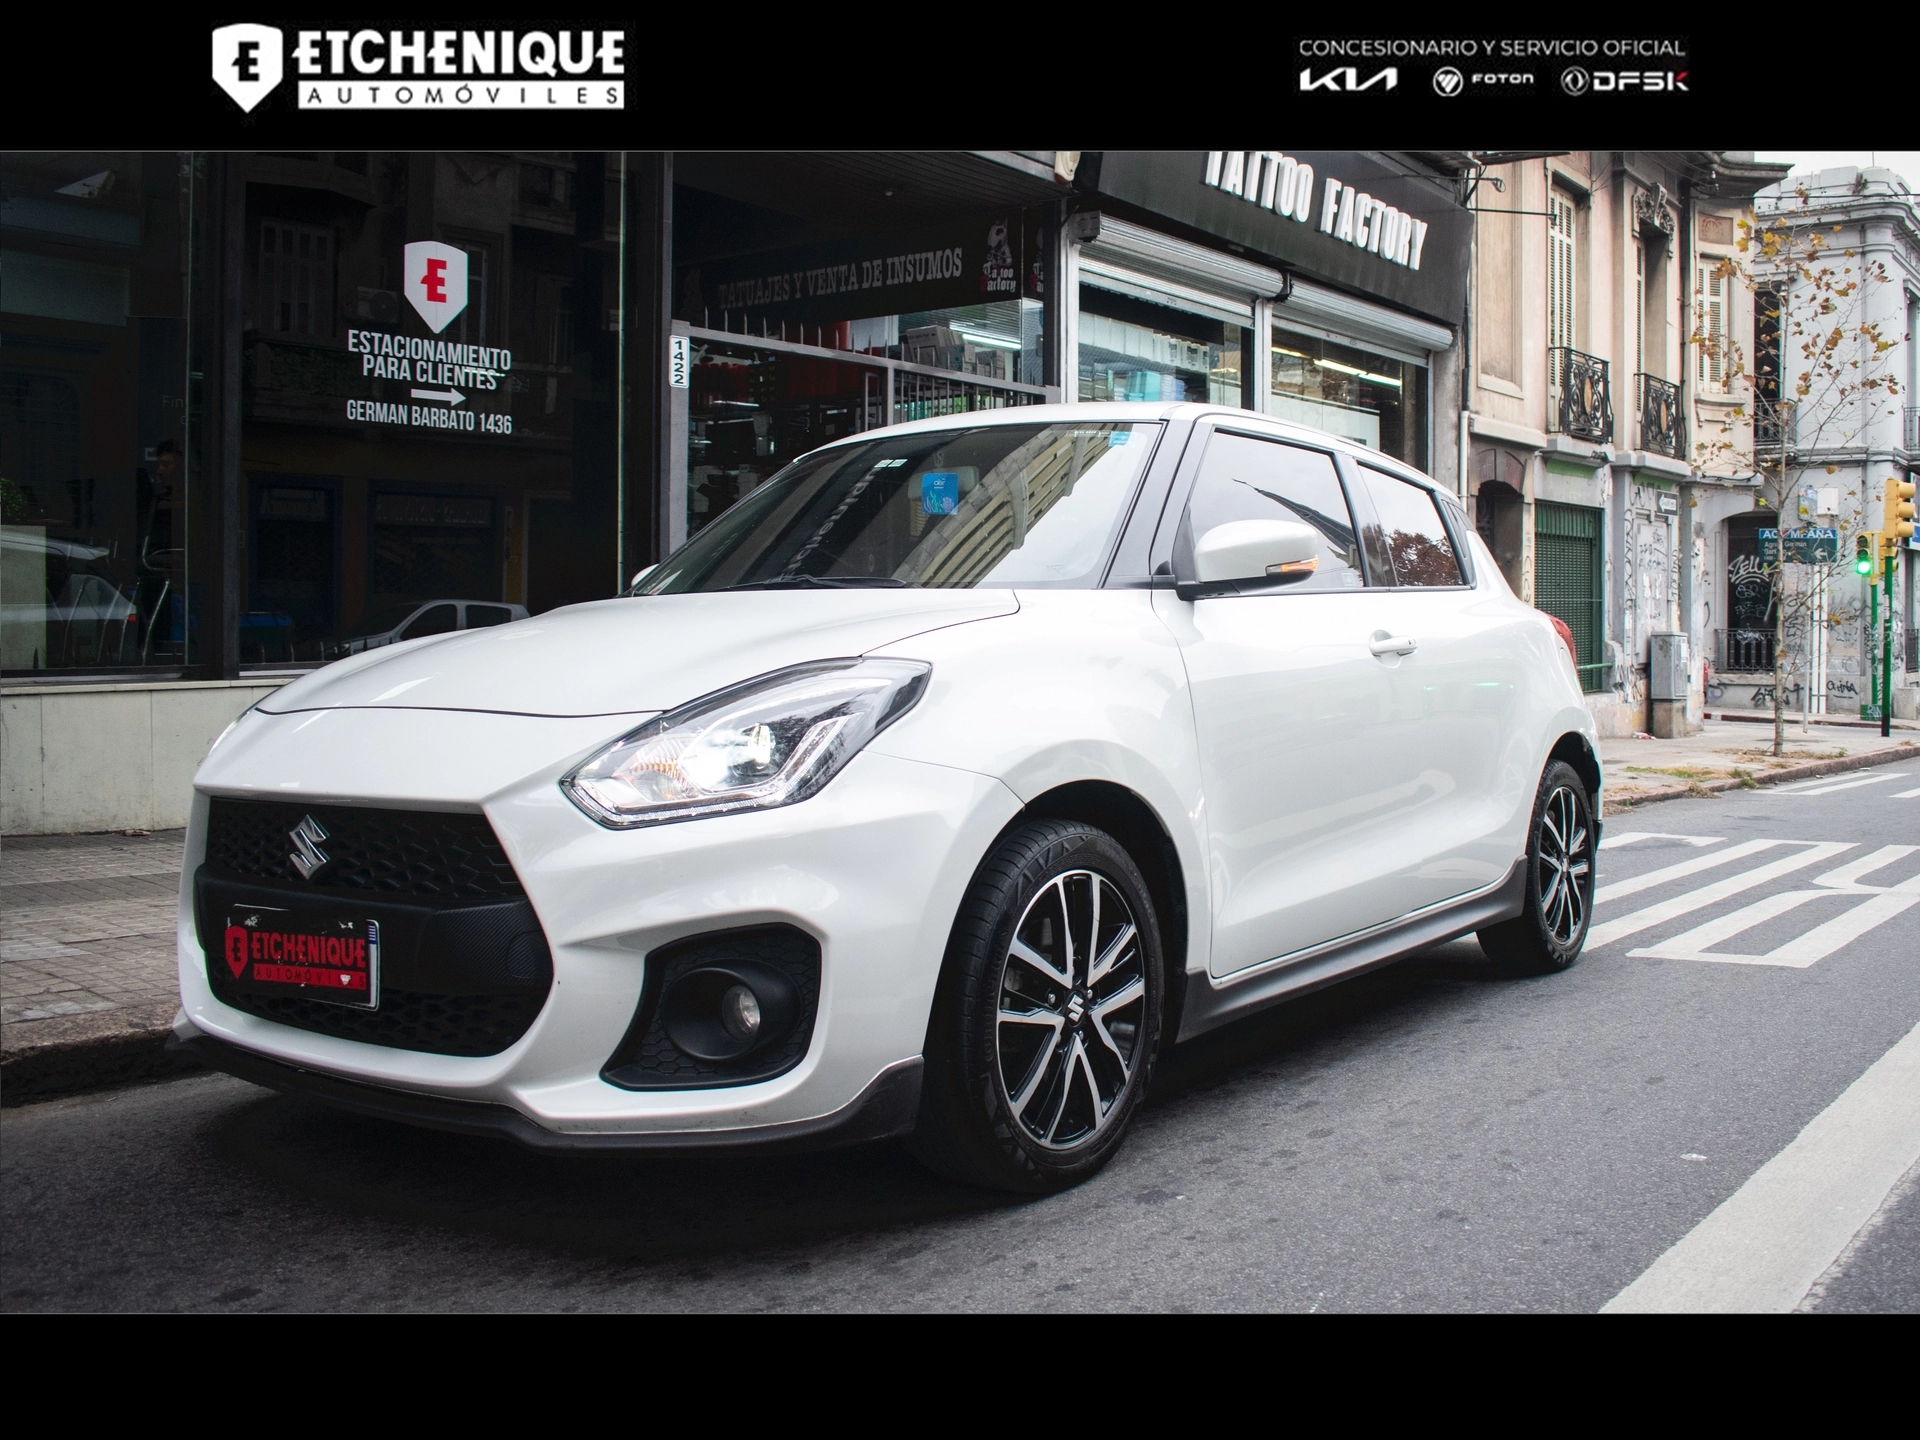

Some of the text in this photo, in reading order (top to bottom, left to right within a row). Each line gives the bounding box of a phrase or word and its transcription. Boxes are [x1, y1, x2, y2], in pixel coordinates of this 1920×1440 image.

[1204, 151, 1428, 271] TATTOO FACTORY
[718, 247, 963, 310] TATUAJES Y VENTA DE INSUMOS
[348, 328, 512, 371] ESTACIONAMIENTO
[673, 340, 685, 384] 1422
[363, 354, 498, 391] PARA CLIENTES
[346, 399, 513, 434] GERMAN BARBATO 1436
[251, 931, 366, 968] ETCHENIQUE
[255, 966, 365, 988] AUTOMÓVIS
